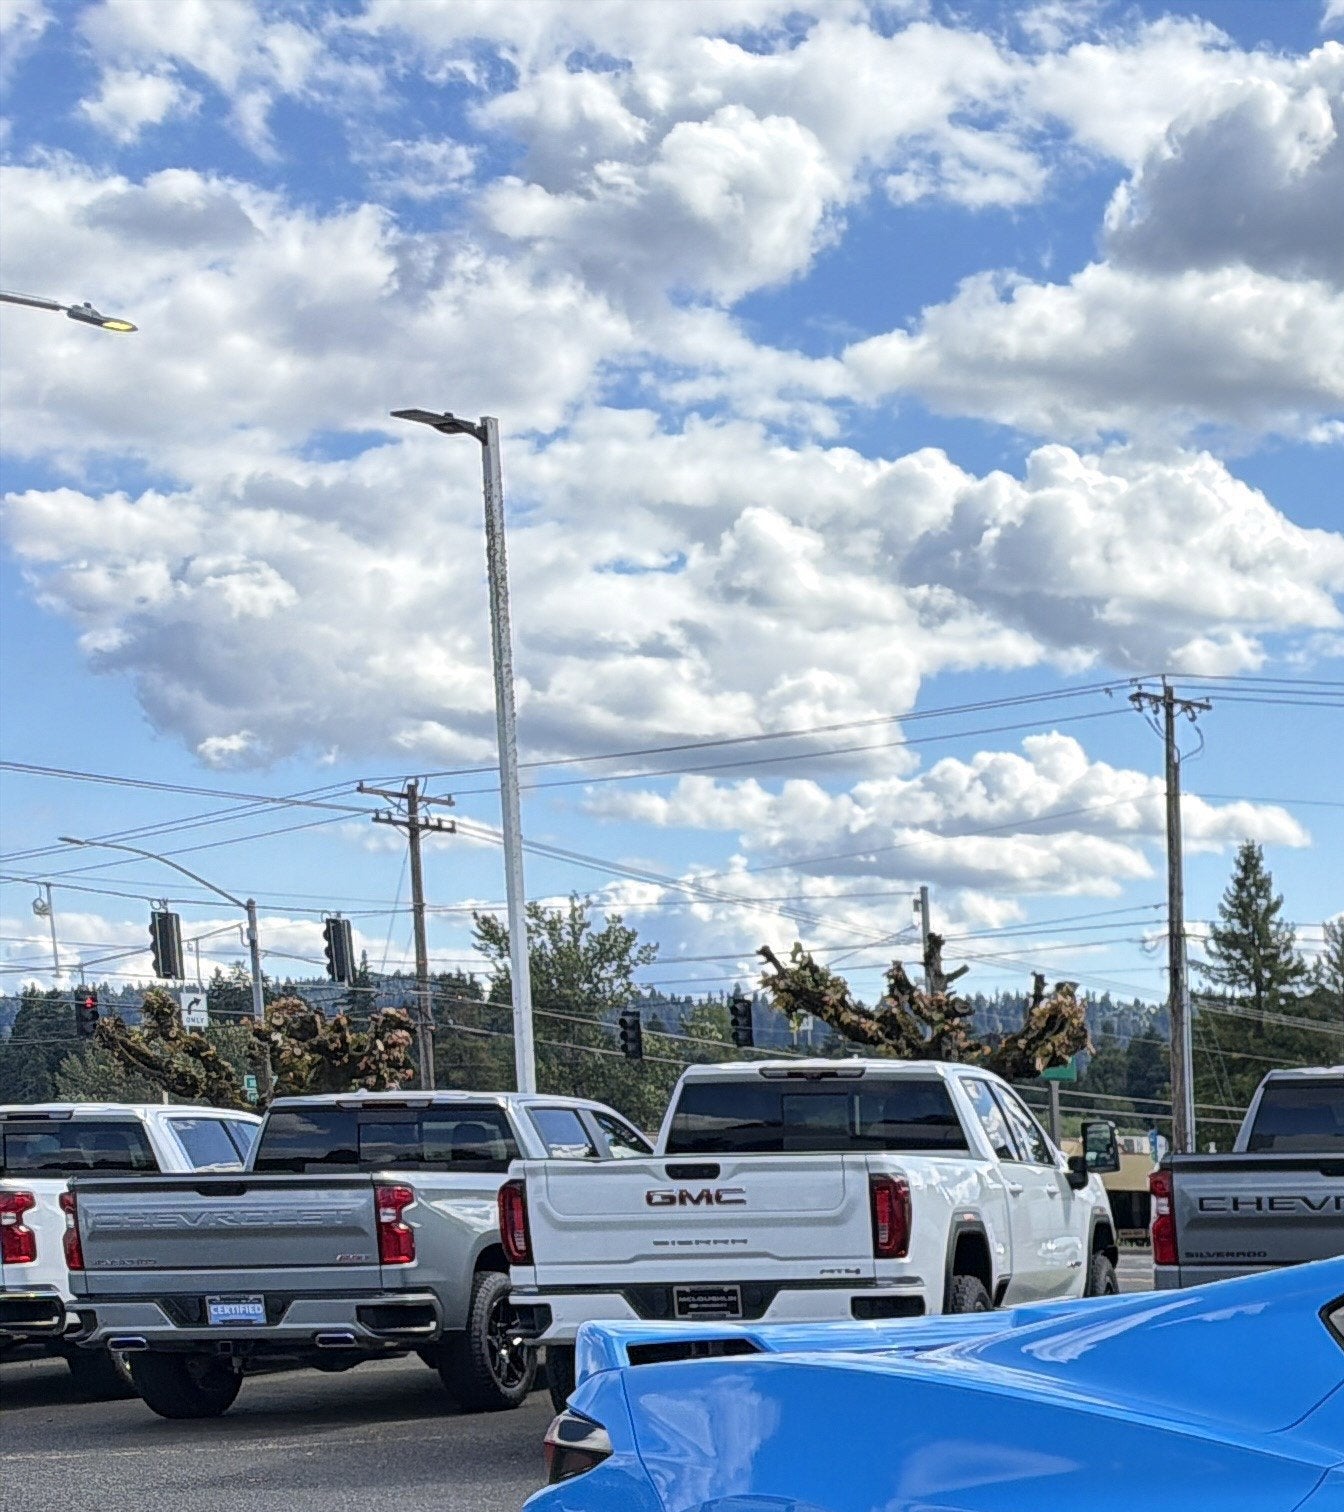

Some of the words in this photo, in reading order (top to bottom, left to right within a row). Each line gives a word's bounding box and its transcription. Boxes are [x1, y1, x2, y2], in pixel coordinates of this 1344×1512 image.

[185, 1016, 205, 1024] ONLY
[645, 1187, 747, 1206] GMC
[1184, 1250, 1268, 1259] SILVERADO
[210, 1303, 264, 1315] CERTIFIED
